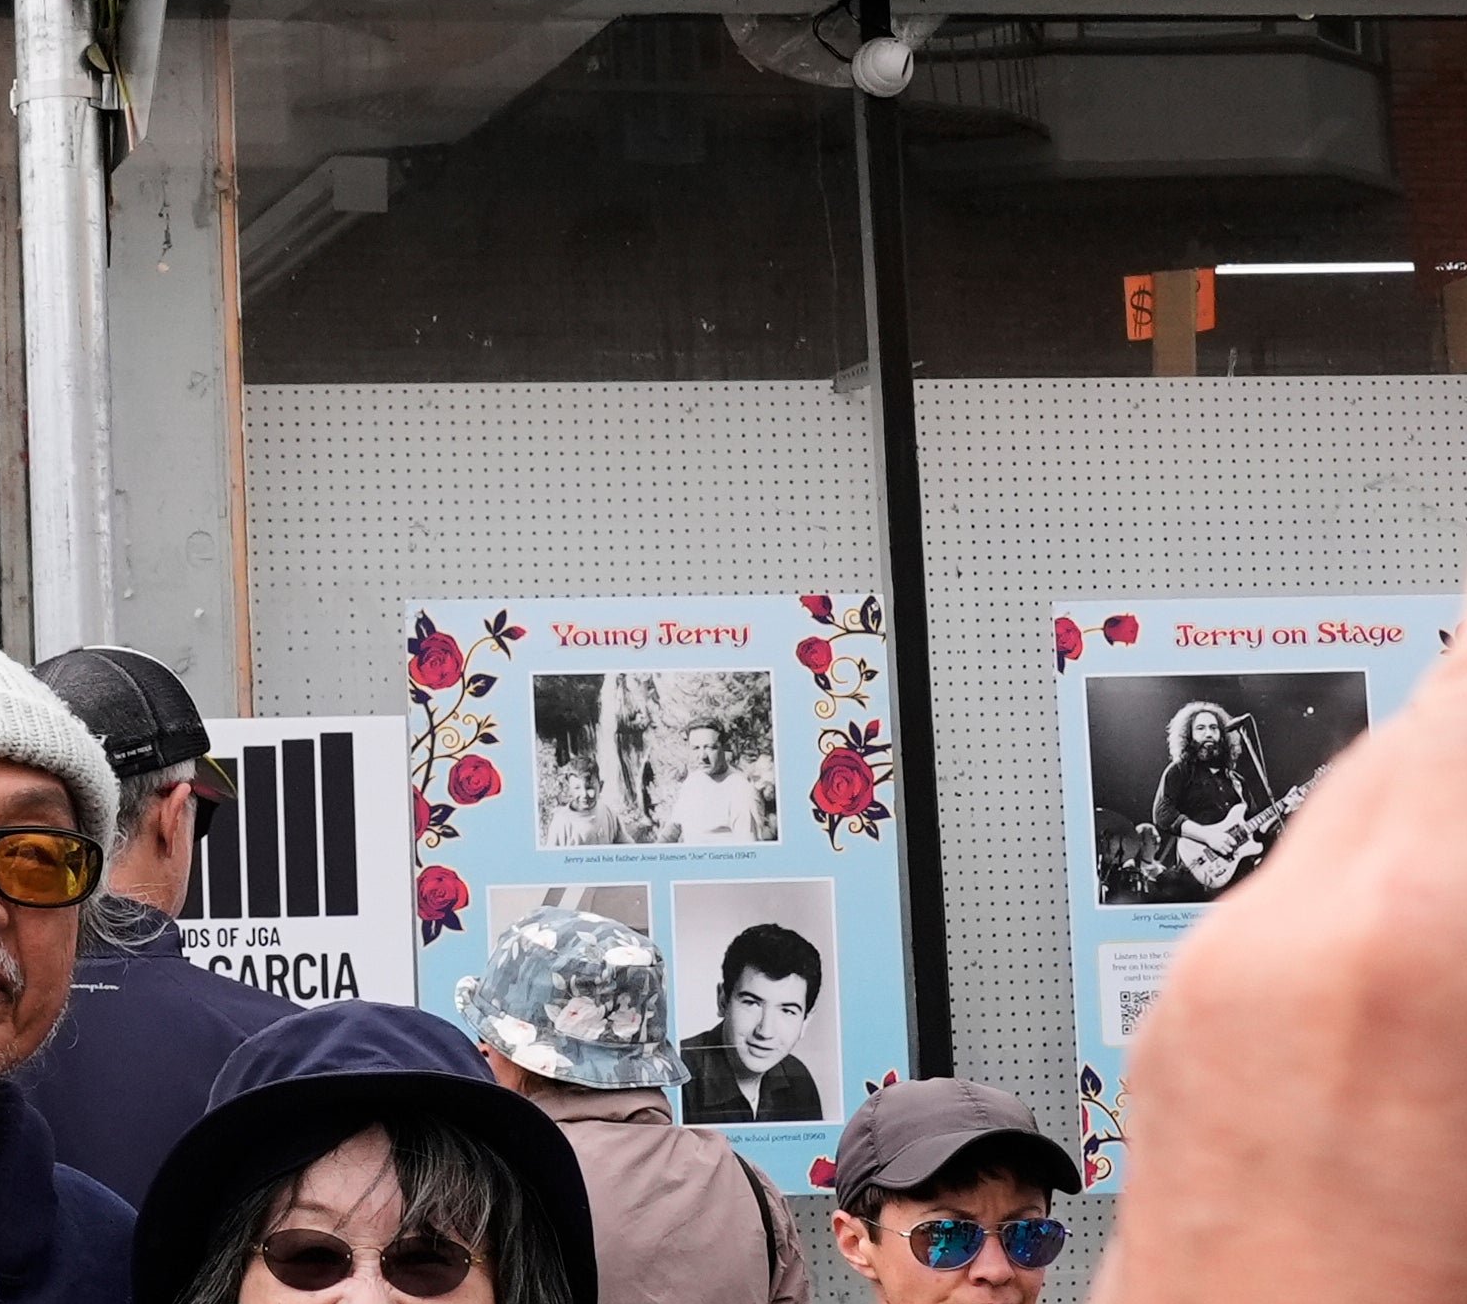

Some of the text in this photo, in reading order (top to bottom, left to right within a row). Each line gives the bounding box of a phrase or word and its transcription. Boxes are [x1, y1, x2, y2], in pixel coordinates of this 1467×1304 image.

[552, 621, 750, 649] Young Jerry
[1175, 620, 1403, 648] Jerry on Stage
[585, 854, 600, 863] and
[602, 854, 614, 863] his
[615, 854, 639, 863] father
[1131, 912, 1151, 921] Jerry
[217, 928, 239, 948] OF
[245, 926, 281, 947] JGA
[69, 982, 120, 993] ampion
